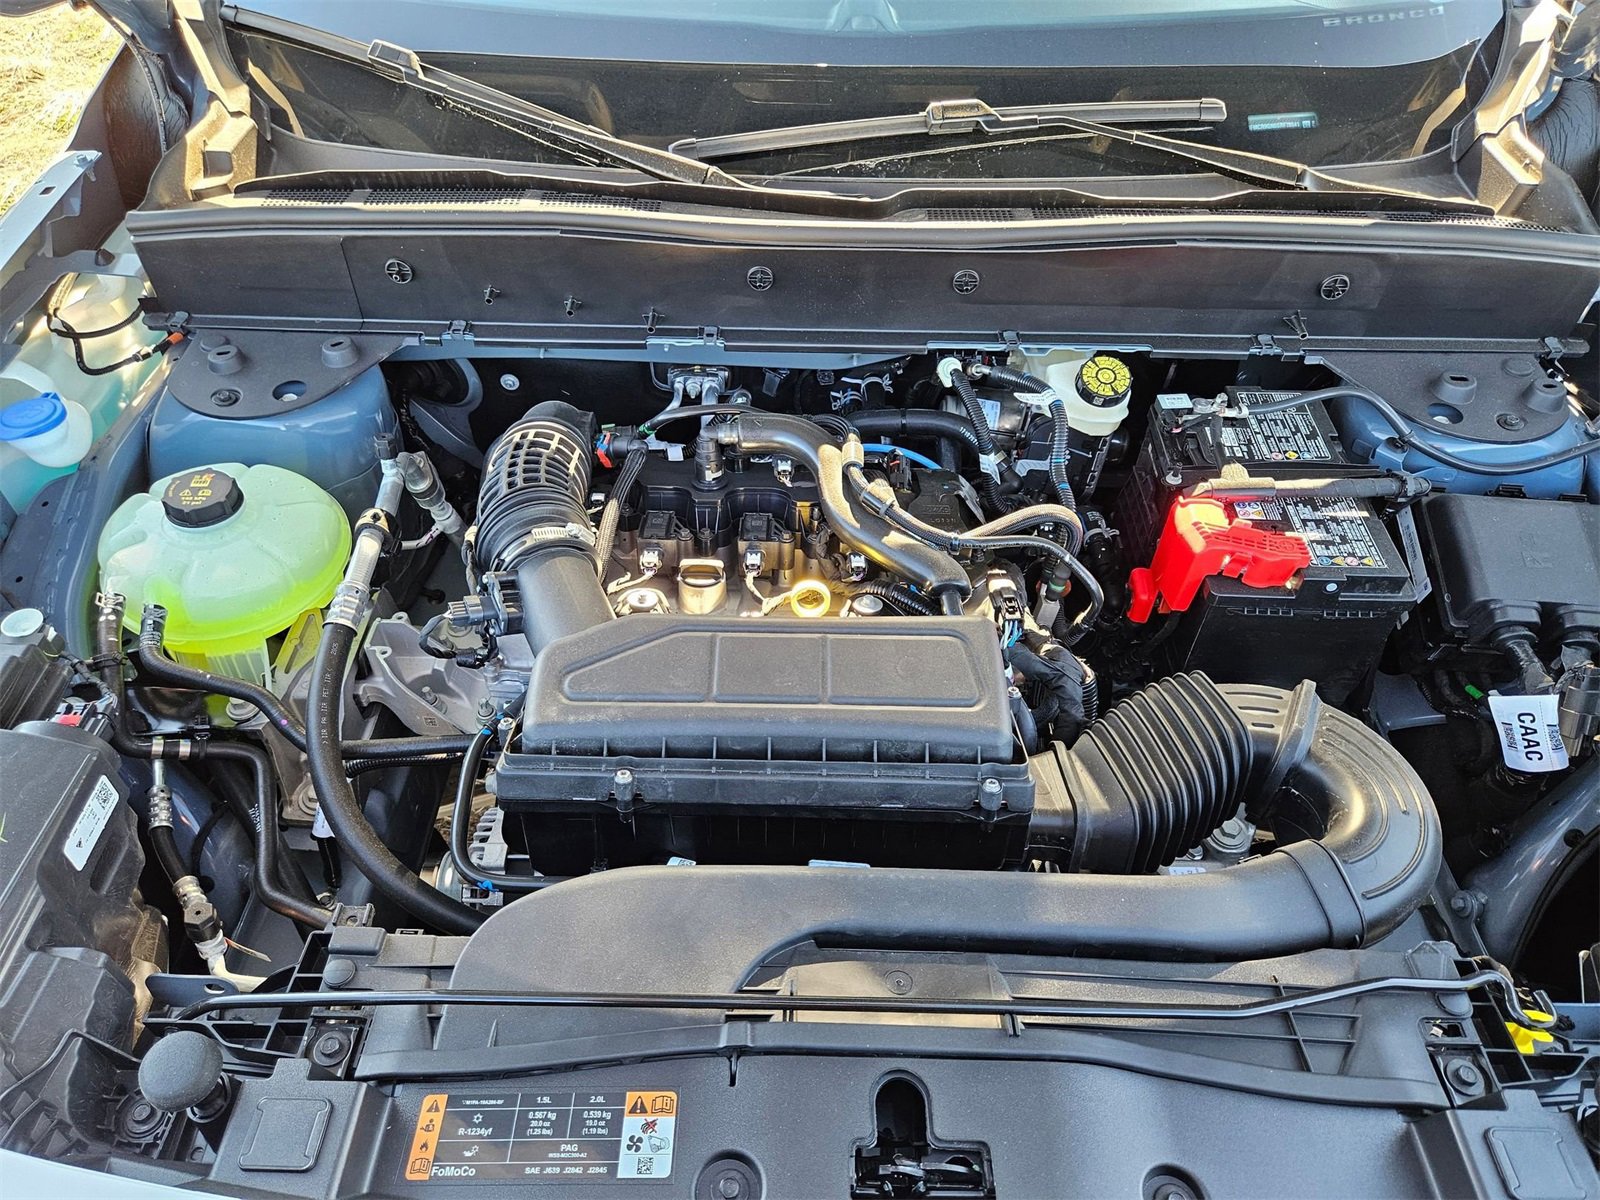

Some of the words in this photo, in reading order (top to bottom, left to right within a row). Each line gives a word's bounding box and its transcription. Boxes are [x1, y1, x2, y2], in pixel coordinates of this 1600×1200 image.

[1322, 6, 1444, 27] BRONCO
[1517, 712, 1544, 761] CAAC
[536, 1096, 552, 1104] 1.5L
[589, 1095, 606, 1103] 2.0L
[547, 1111, 557, 1121] kg
[602, 1110, 612, 1120] kg
[458, 1127, 493, 1137] R-1234yf
[431, 1166, 476, 1177] FoMoCo
[563, 1166, 583, 1174] J2842
[587, 1166, 608, 1174] J2845
